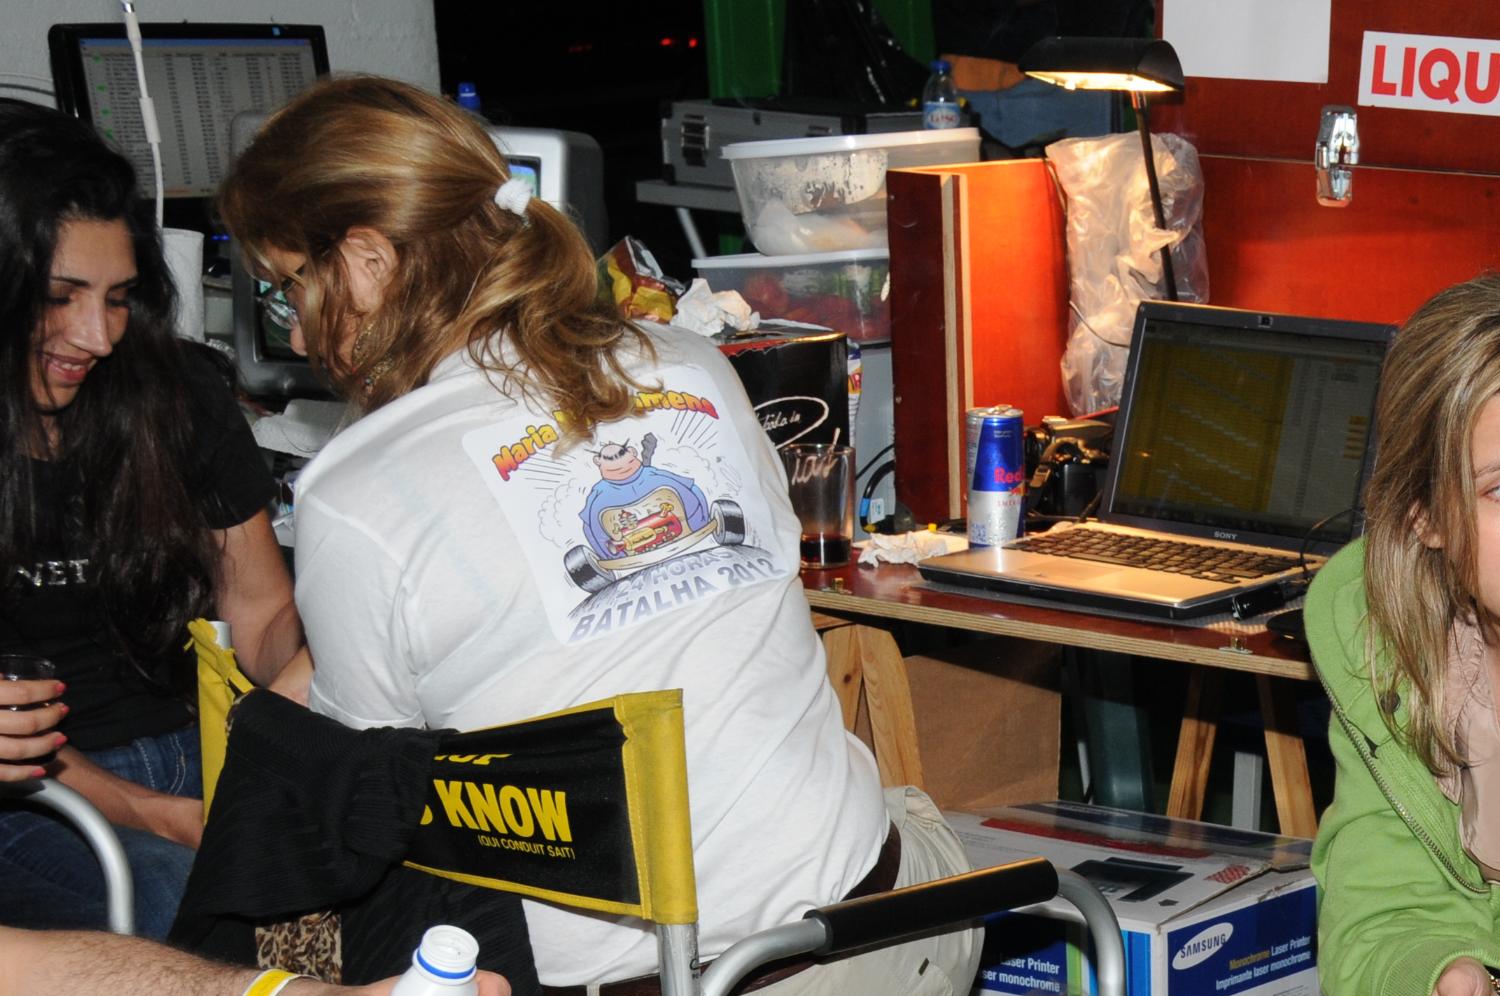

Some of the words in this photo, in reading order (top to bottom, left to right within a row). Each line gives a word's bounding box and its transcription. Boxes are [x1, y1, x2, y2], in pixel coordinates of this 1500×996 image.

[492, 424, 559, 481] Maria
[1214, 531, 1238, 540] SONY
[568, 576, 720, 641] BATALHA
[717, 558, 788, 586] 2012
[433, 779, 573, 842] KNOW
[477, 834, 500, 848] (QUI
[500, 838, 545, 855] CONDUIT
[546, 846, 576, 861] SAIT)
[1181, 933, 1226, 958] SAMSUNG
[1229, 950, 1270, 970] Monochrome
[1271, 943, 1288, 955] Laser
[1290, 936, 1311, 950] Printer
[1027, 957, 1061, 975] Printer
[1216, 970, 1252, 990] Imprimante
[1254, 964, 1269, 975] laser
[1271, 951, 1311, 970] monochrome
[998, 972, 1061, 993] monochrome
